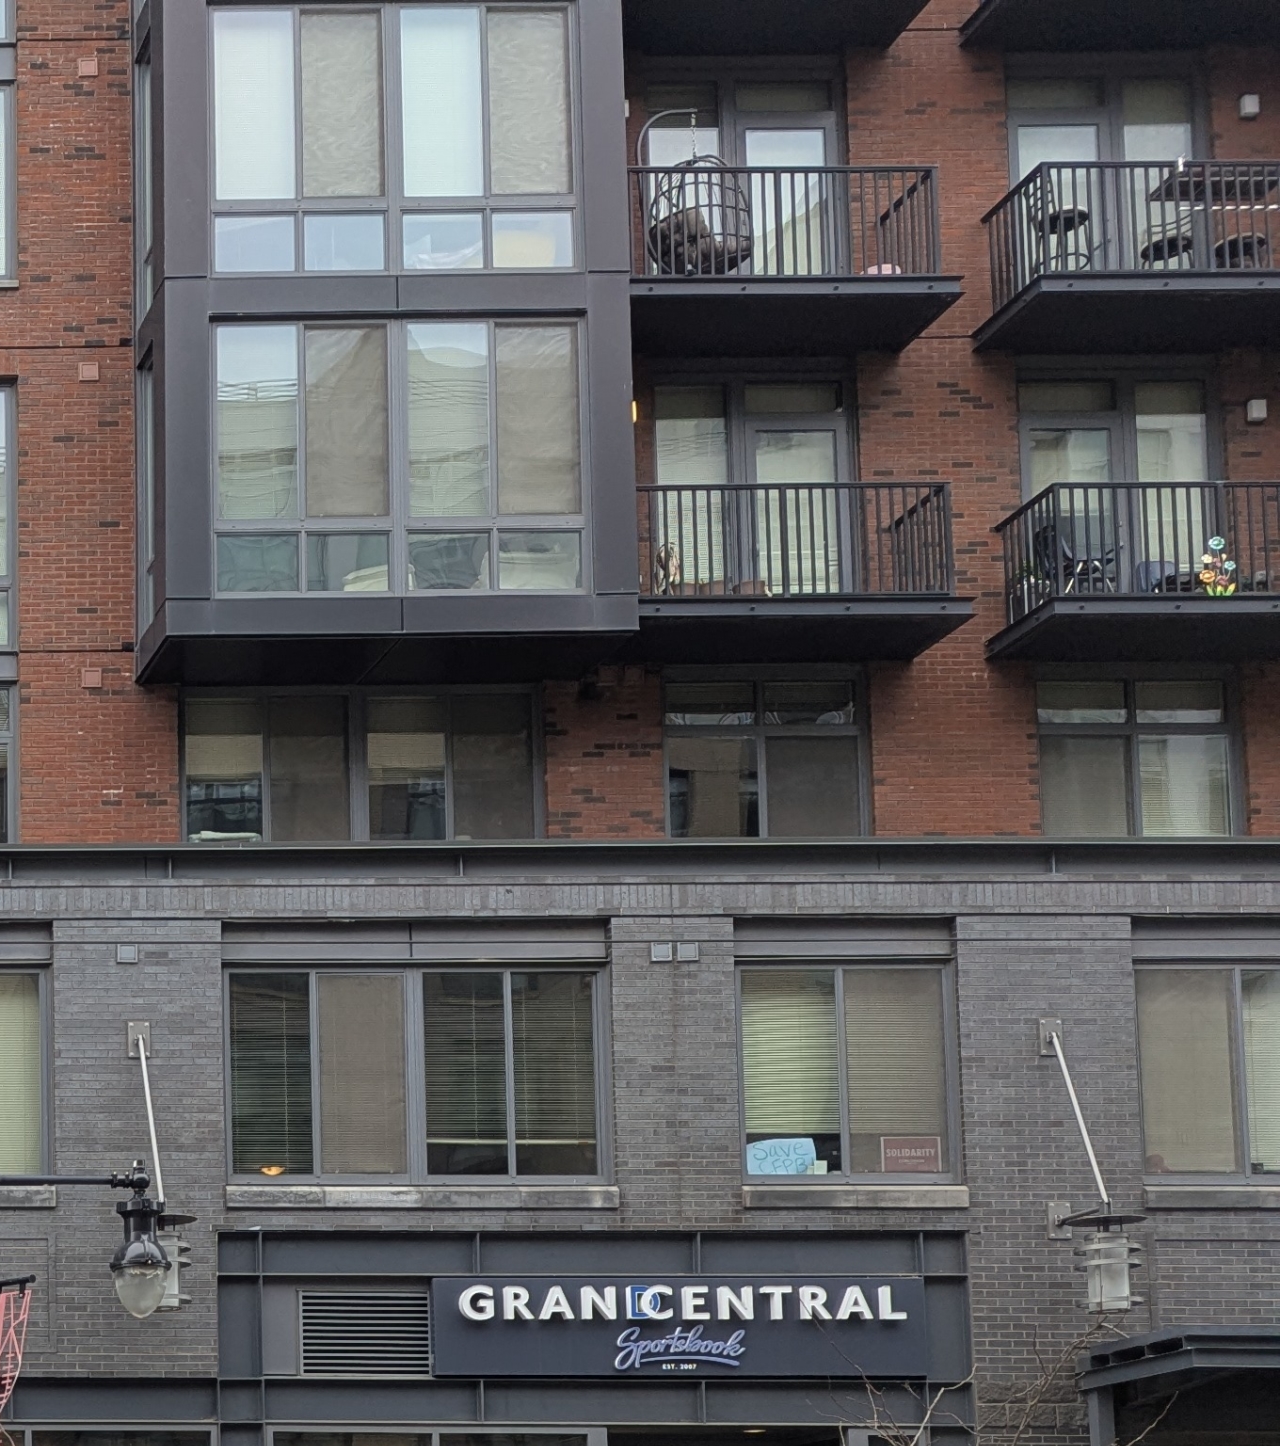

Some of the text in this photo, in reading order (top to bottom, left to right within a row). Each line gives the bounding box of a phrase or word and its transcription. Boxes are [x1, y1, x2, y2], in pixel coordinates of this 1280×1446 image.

[753, 1142, 809, 1161] Save
[885, 1148, 936, 1157] SOLIDARITY
[614, 1325, 747, 1370] Sportsbook
